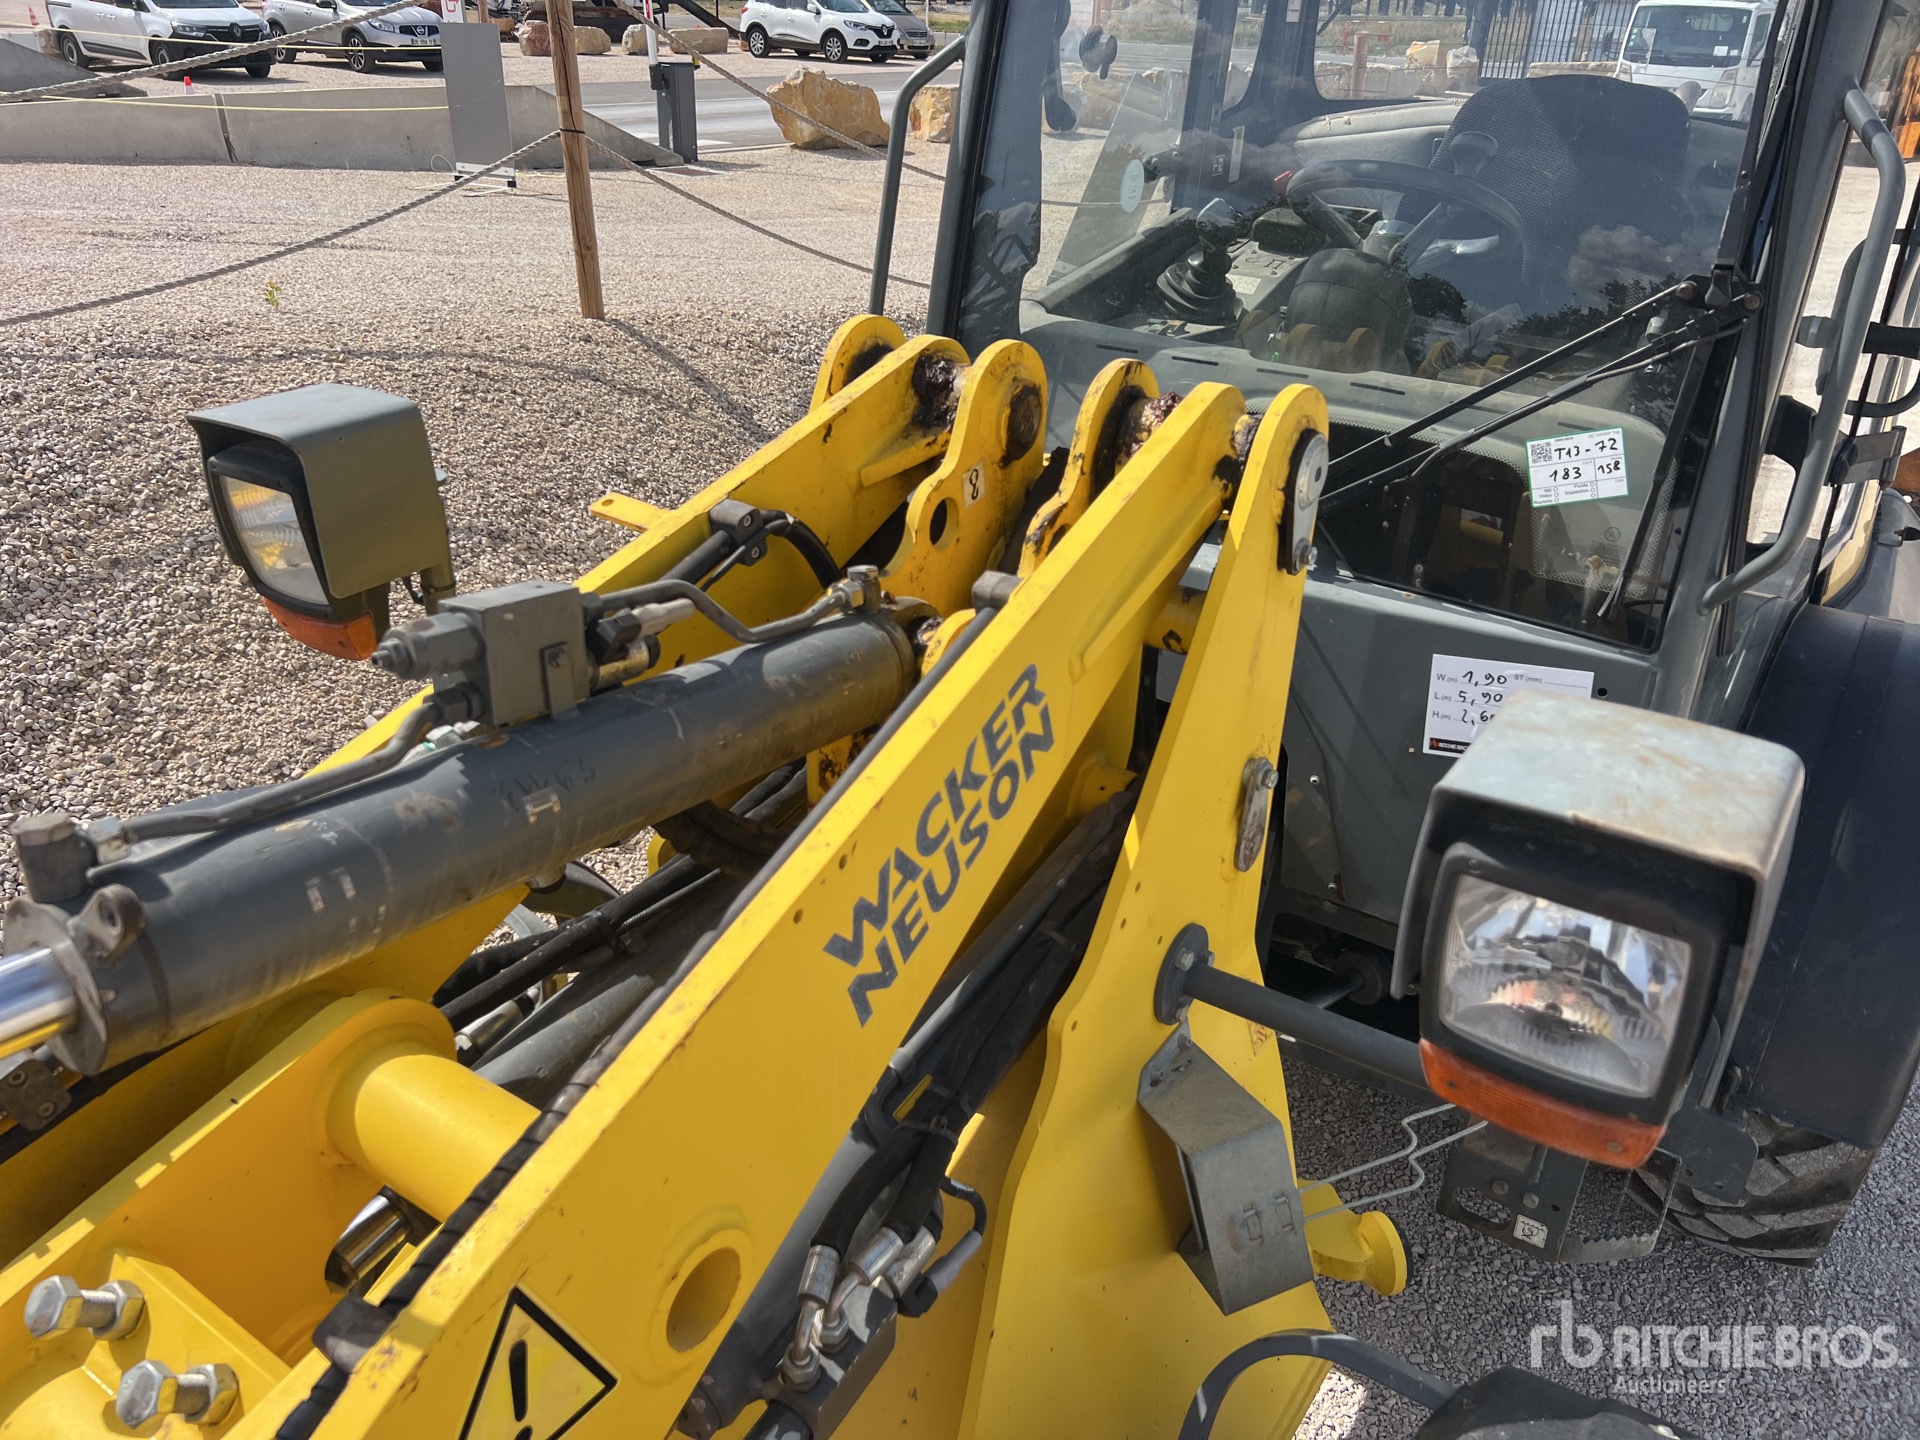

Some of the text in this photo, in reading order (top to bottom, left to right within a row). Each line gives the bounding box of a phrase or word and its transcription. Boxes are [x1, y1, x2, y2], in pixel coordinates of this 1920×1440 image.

[1549, 466, 1582, 482] 183
[1597, 460, 1621, 474] 158
[823, 664, 1047, 967] WACKER
[847, 702, 1055, 1028] NEUSON
